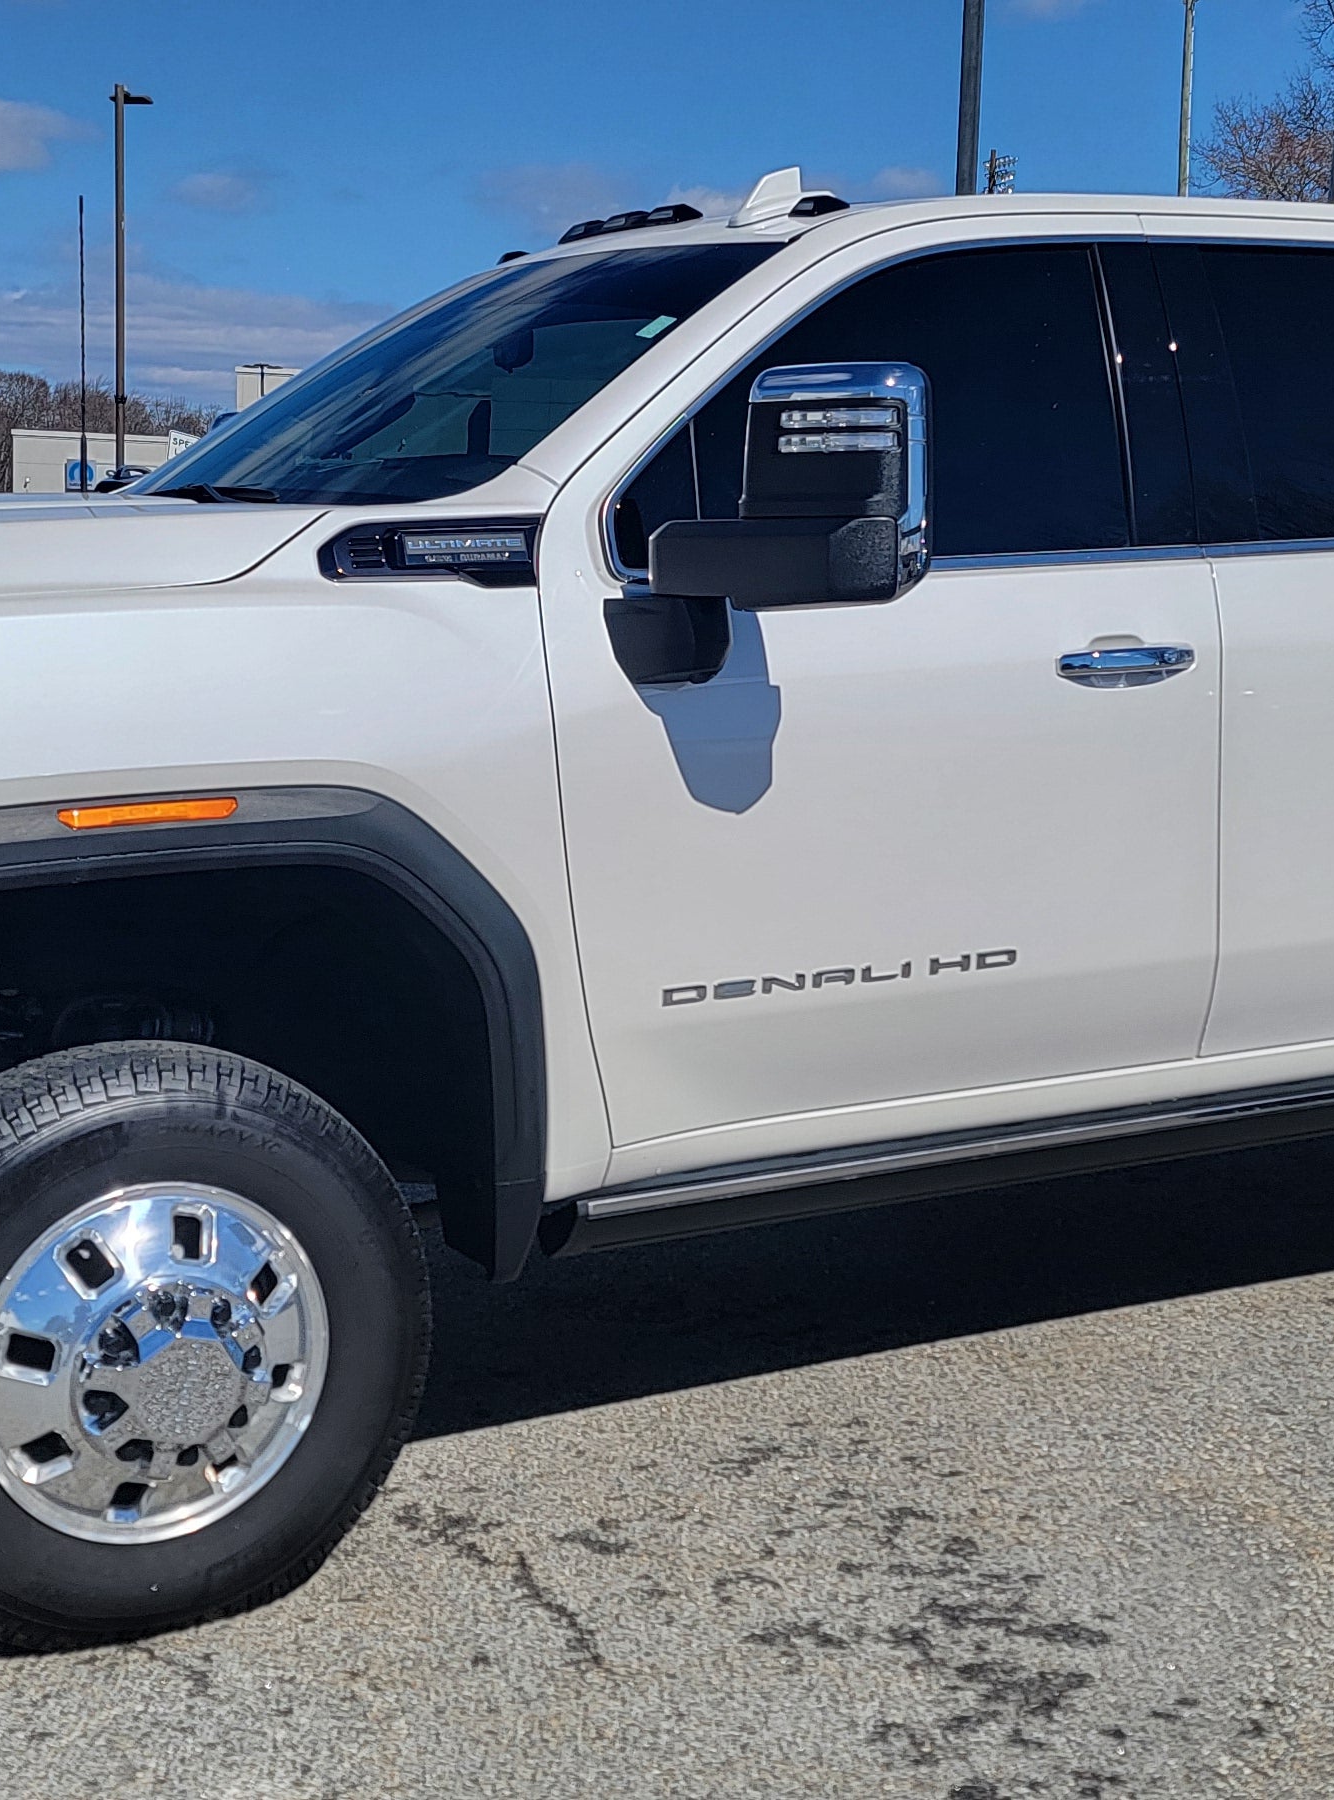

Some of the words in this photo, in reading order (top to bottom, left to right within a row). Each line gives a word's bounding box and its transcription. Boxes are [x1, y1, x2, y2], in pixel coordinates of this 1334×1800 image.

[172, 437, 194, 449] SPE
[407, 538, 522, 551] ULTIMATE
[661, 960, 912, 1008] DENALI
[928, 948, 1017, 976] HD
